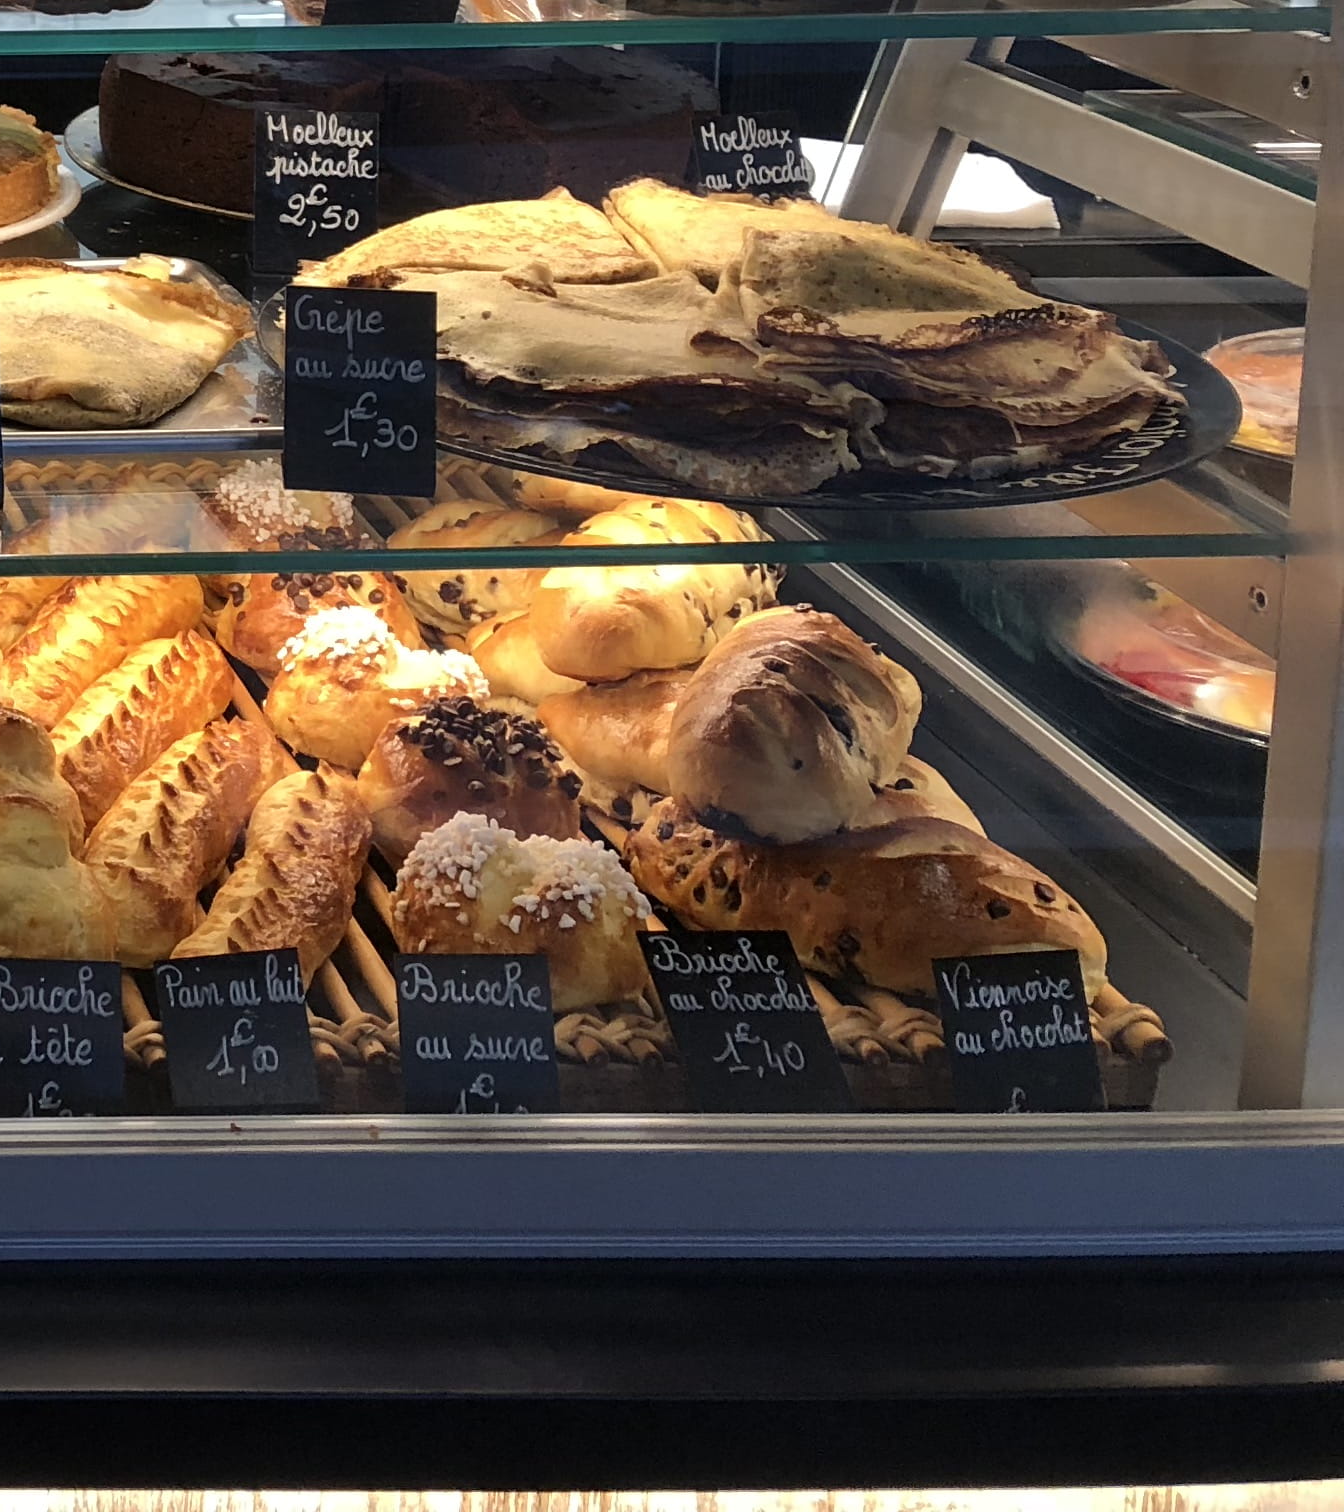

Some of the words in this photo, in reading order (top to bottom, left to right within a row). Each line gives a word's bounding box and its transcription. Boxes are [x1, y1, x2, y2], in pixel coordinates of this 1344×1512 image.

[266, 112, 373, 148] Moelleux
[701, 116, 793, 153] Moelleux
[266, 148, 377, 184] pistache
[702, 173, 732, 192] au
[294, 354, 332, 379] au
[343, 354, 426, 382] sucre
[648, 936, 784, 976] Brioche
[159, 967, 220, 1008] Pain
[230, 978, 261, 1005] au
[266, 954, 304, 1004] lait
[401, 963, 547, 1012] Brioche
[670, 993, 704, 1013] au
[711, 978, 818, 1013] chocolat
[941, 963, 1076, 1012] Viennoise
[21, 1024, 93, 1066] tête
[417, 1035, 451, 1058] au
[465, 1033, 549, 1063] sucre
[955, 1032, 985, 1055] au
[990, 1005, 1088, 1052] chocolat
